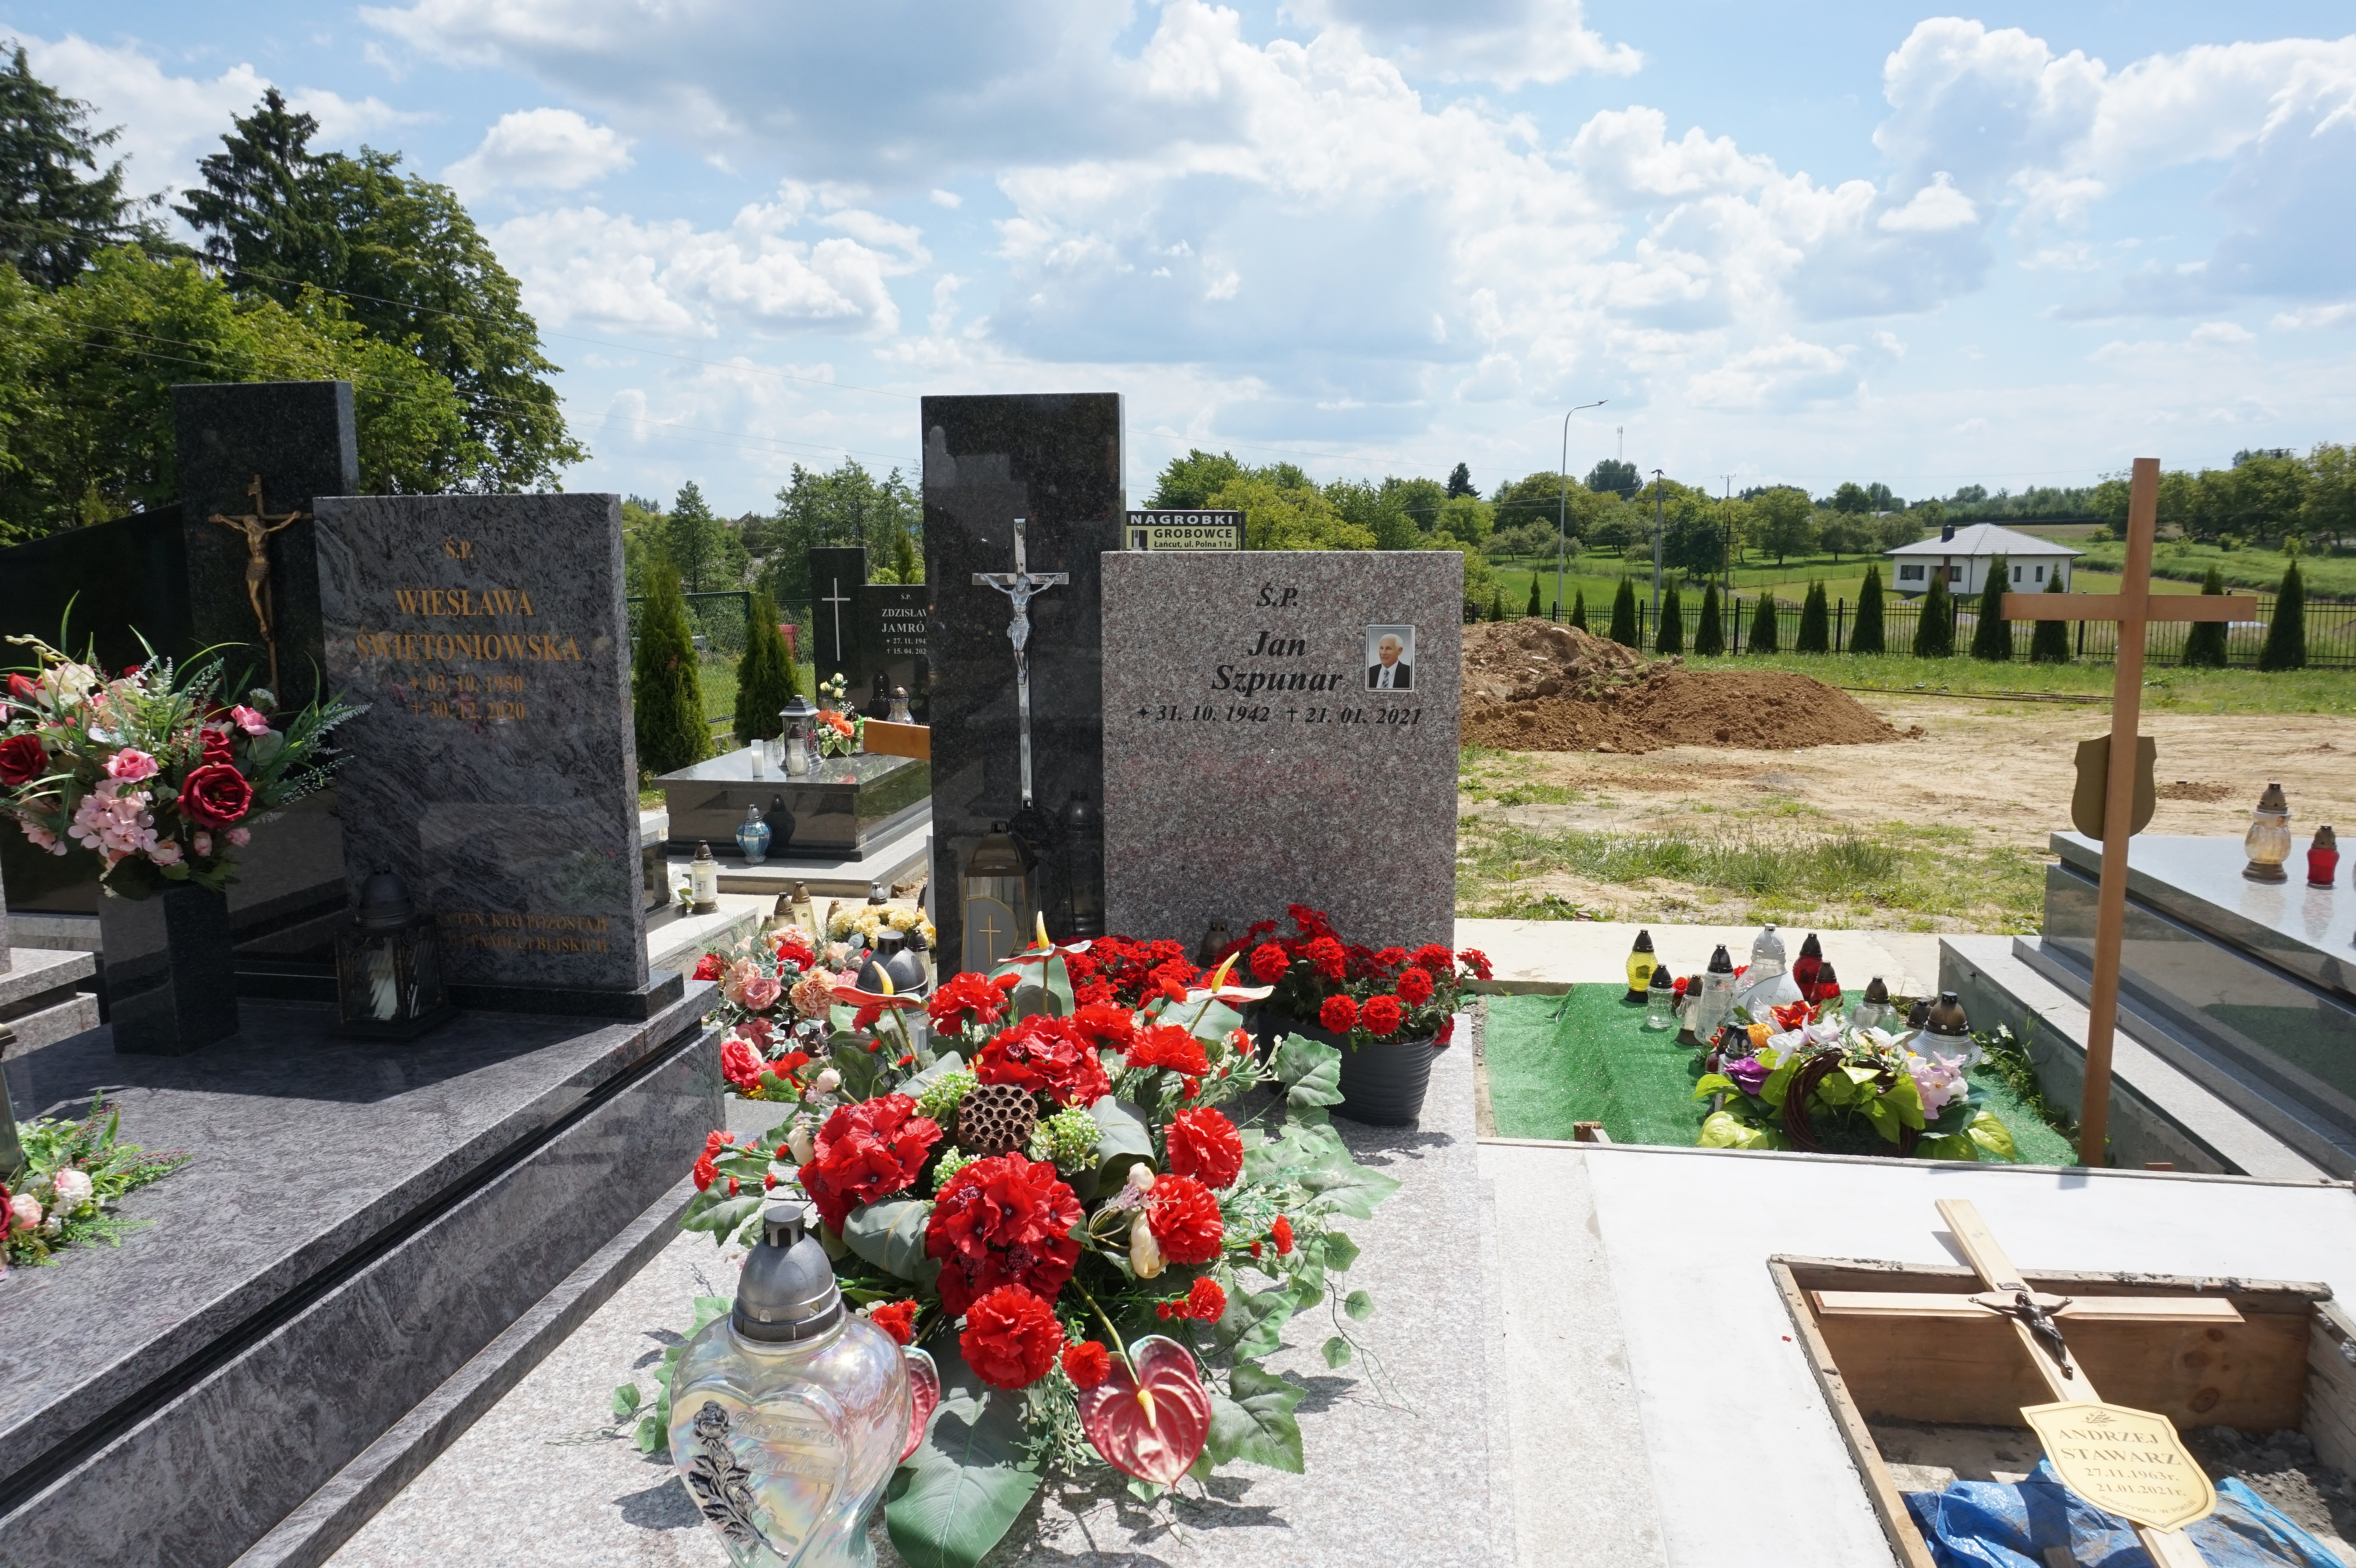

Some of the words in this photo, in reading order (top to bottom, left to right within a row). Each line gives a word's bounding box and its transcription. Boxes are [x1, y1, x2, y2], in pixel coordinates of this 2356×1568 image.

[1130, 515, 1232, 525] NAGROBKI
[1154, 529, 1232, 538] GROBOWCE
[444, 536, 474, 559] Ś.P.
[1154, 540, 1182, 549] Łańcut,
[395, 589, 535, 616] WIESŁAWA
[1256, 582, 1299, 607] Ś.P.
[882, 621, 927, 632] JAMRÓ
[355, 626, 581, 667] ŚWIĘTONIOWSKA
[1248, 631, 1306, 658] Jan
[487, 675, 523, 692] 1950
[1211, 664, 1343, 698] Szpunar
[487, 702, 524, 719] 2020
[1226, 706, 1270, 722] 1942
[1375, 708, 1423, 725] 2021
[527, 915, 611, 932] POZOSTAJE
[2059, 1429, 2159, 1444] ANDRZEJ
[2060, 1448, 2182, 1465] STAWARZ
[2084, 1468, 2179, 1481] 27.11.1963r.
[2096, 1483, 2187, 1496] 21.01.2021r.
[2100, 1495, 2156, 1514] SPOCZYWAJ
[2171, 1499, 2197, 1513] POKOJU
